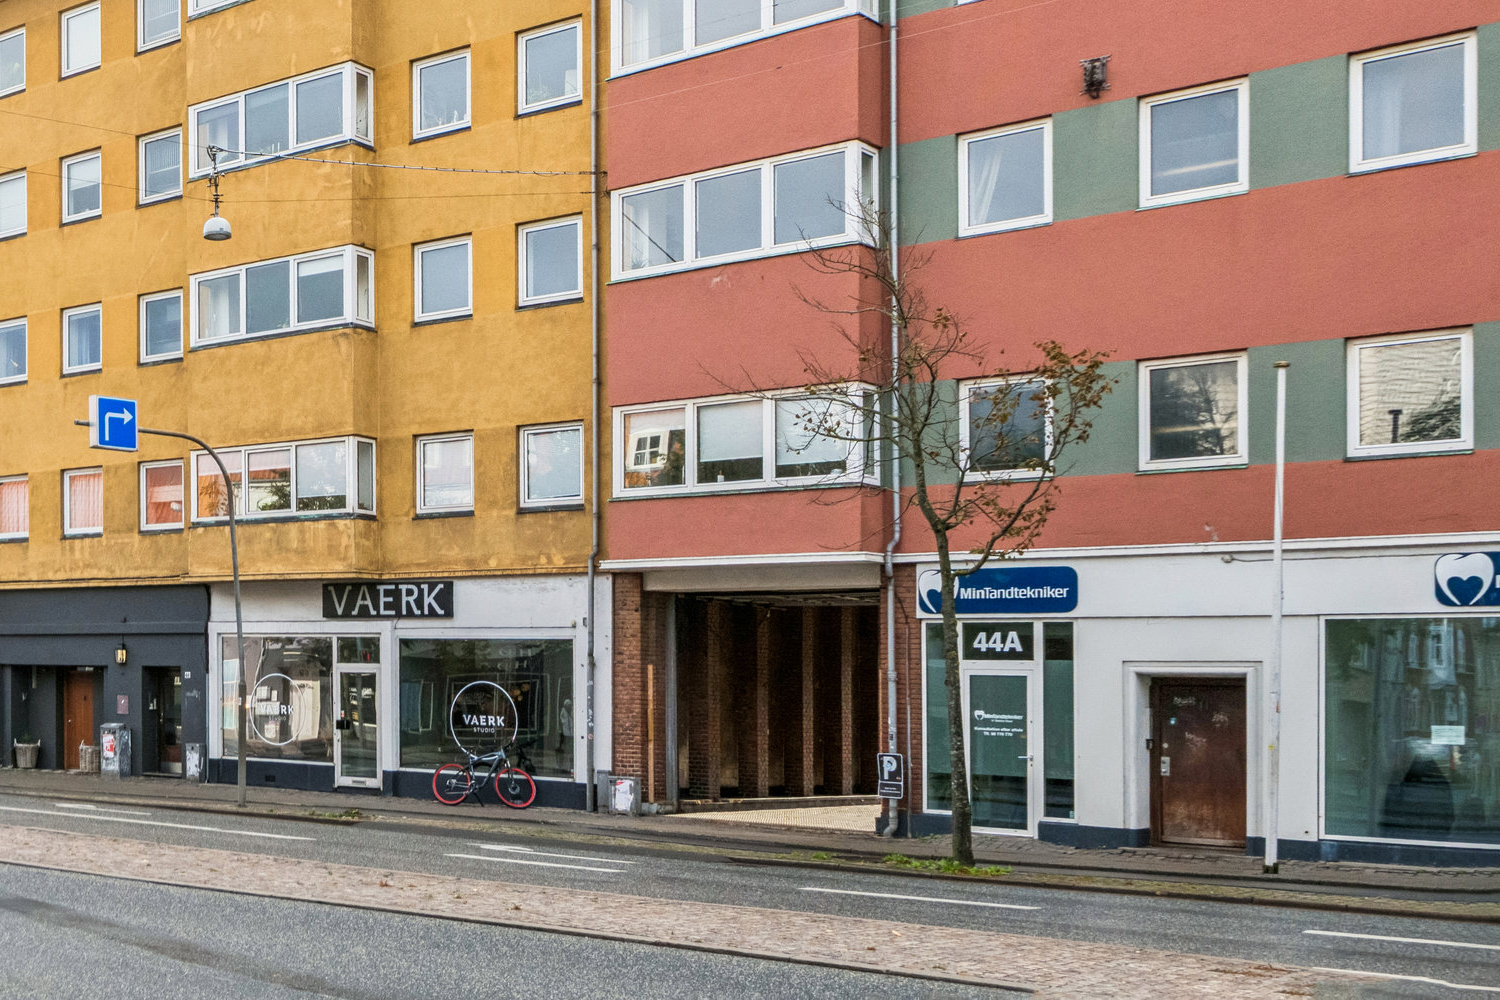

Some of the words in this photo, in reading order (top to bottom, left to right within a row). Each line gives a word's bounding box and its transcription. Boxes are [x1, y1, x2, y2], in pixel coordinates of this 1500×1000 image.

[328, 583, 445, 616] VAERK
[960, 586, 1069, 600] MinTandtekniker
[972, 631, 1023, 652] 44A
[260, 704, 294, 715] VAERK
[463, 714, 505, 727] VAERK
